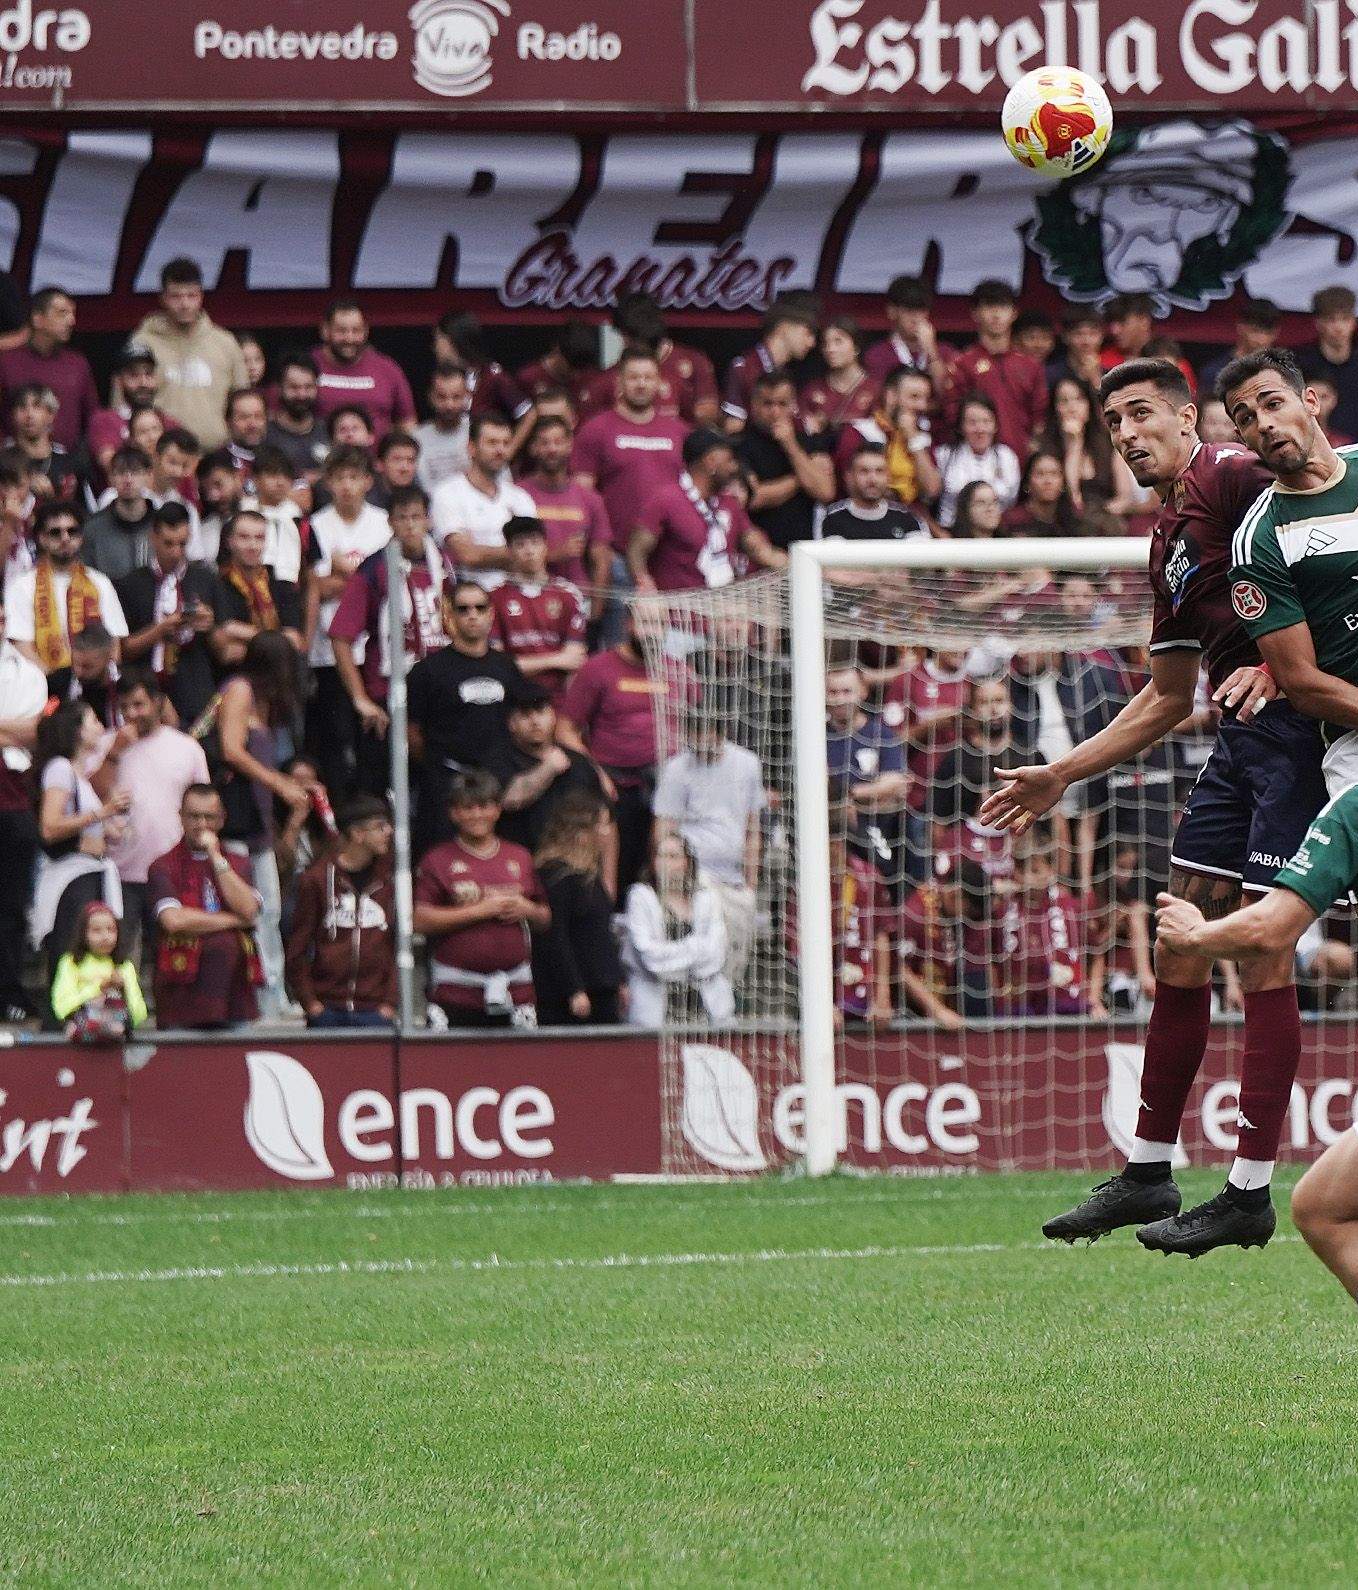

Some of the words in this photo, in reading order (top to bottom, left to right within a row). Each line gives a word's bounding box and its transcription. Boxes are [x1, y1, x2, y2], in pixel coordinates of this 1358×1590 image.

[194, 20, 398, 60] Pontevedra
[517, 21, 622, 61] Radio
[801, 0, 1163, 95] Estrella
[502, 230, 797, 310] Granates
[1248, 850, 1290, 869] ABAN
[338, 1086, 556, 1161] ence
[772, 1081, 983, 1154] ence
